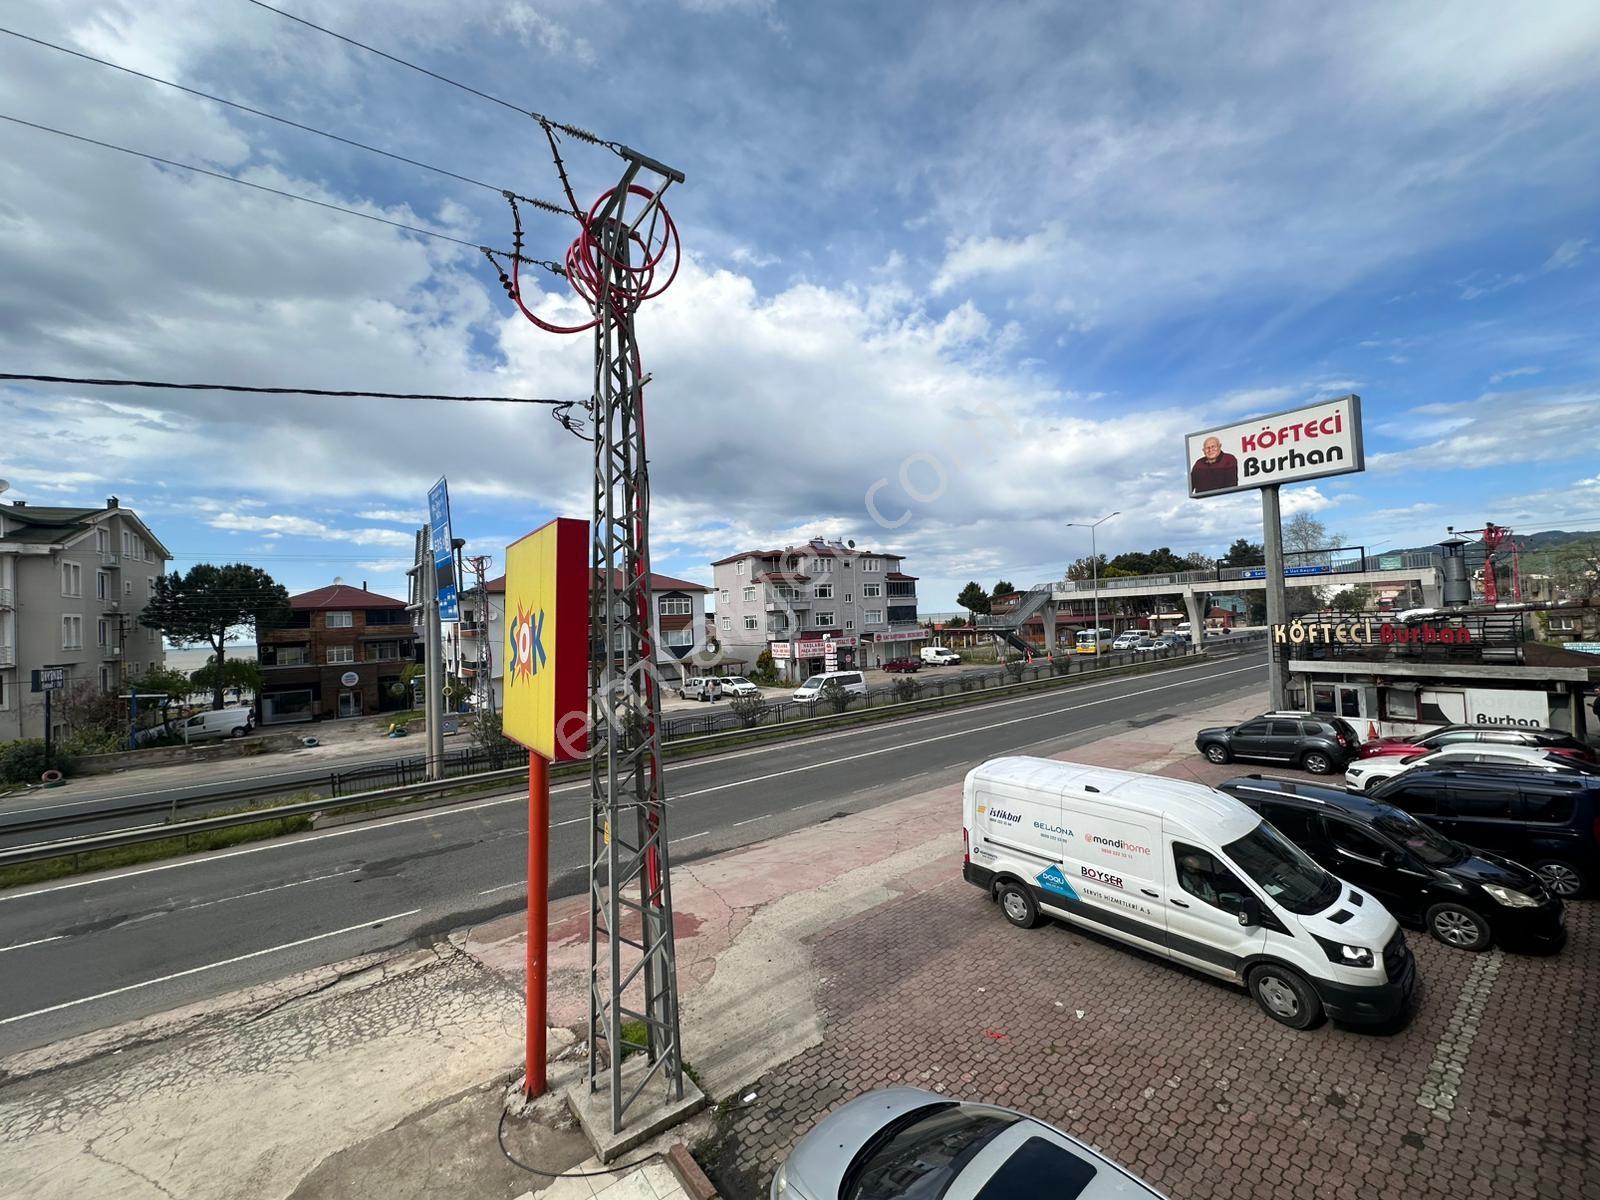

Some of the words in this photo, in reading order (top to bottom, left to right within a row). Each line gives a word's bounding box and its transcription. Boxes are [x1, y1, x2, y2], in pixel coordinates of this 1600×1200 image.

[1241, 409, 1342, 453] KÖFTECİ
[1243, 445, 1343, 477] Burhan
[1273, 618, 1373, 644] KÖFTECİ
[1379, 623, 1472, 644] Burhan
[1476, 713, 1540, 727] Burhan
[1033, 821, 1074, 837] BELLONA
[1093, 835, 1151, 855] mondihome
[1081, 866, 1123, 887] BOYSER
